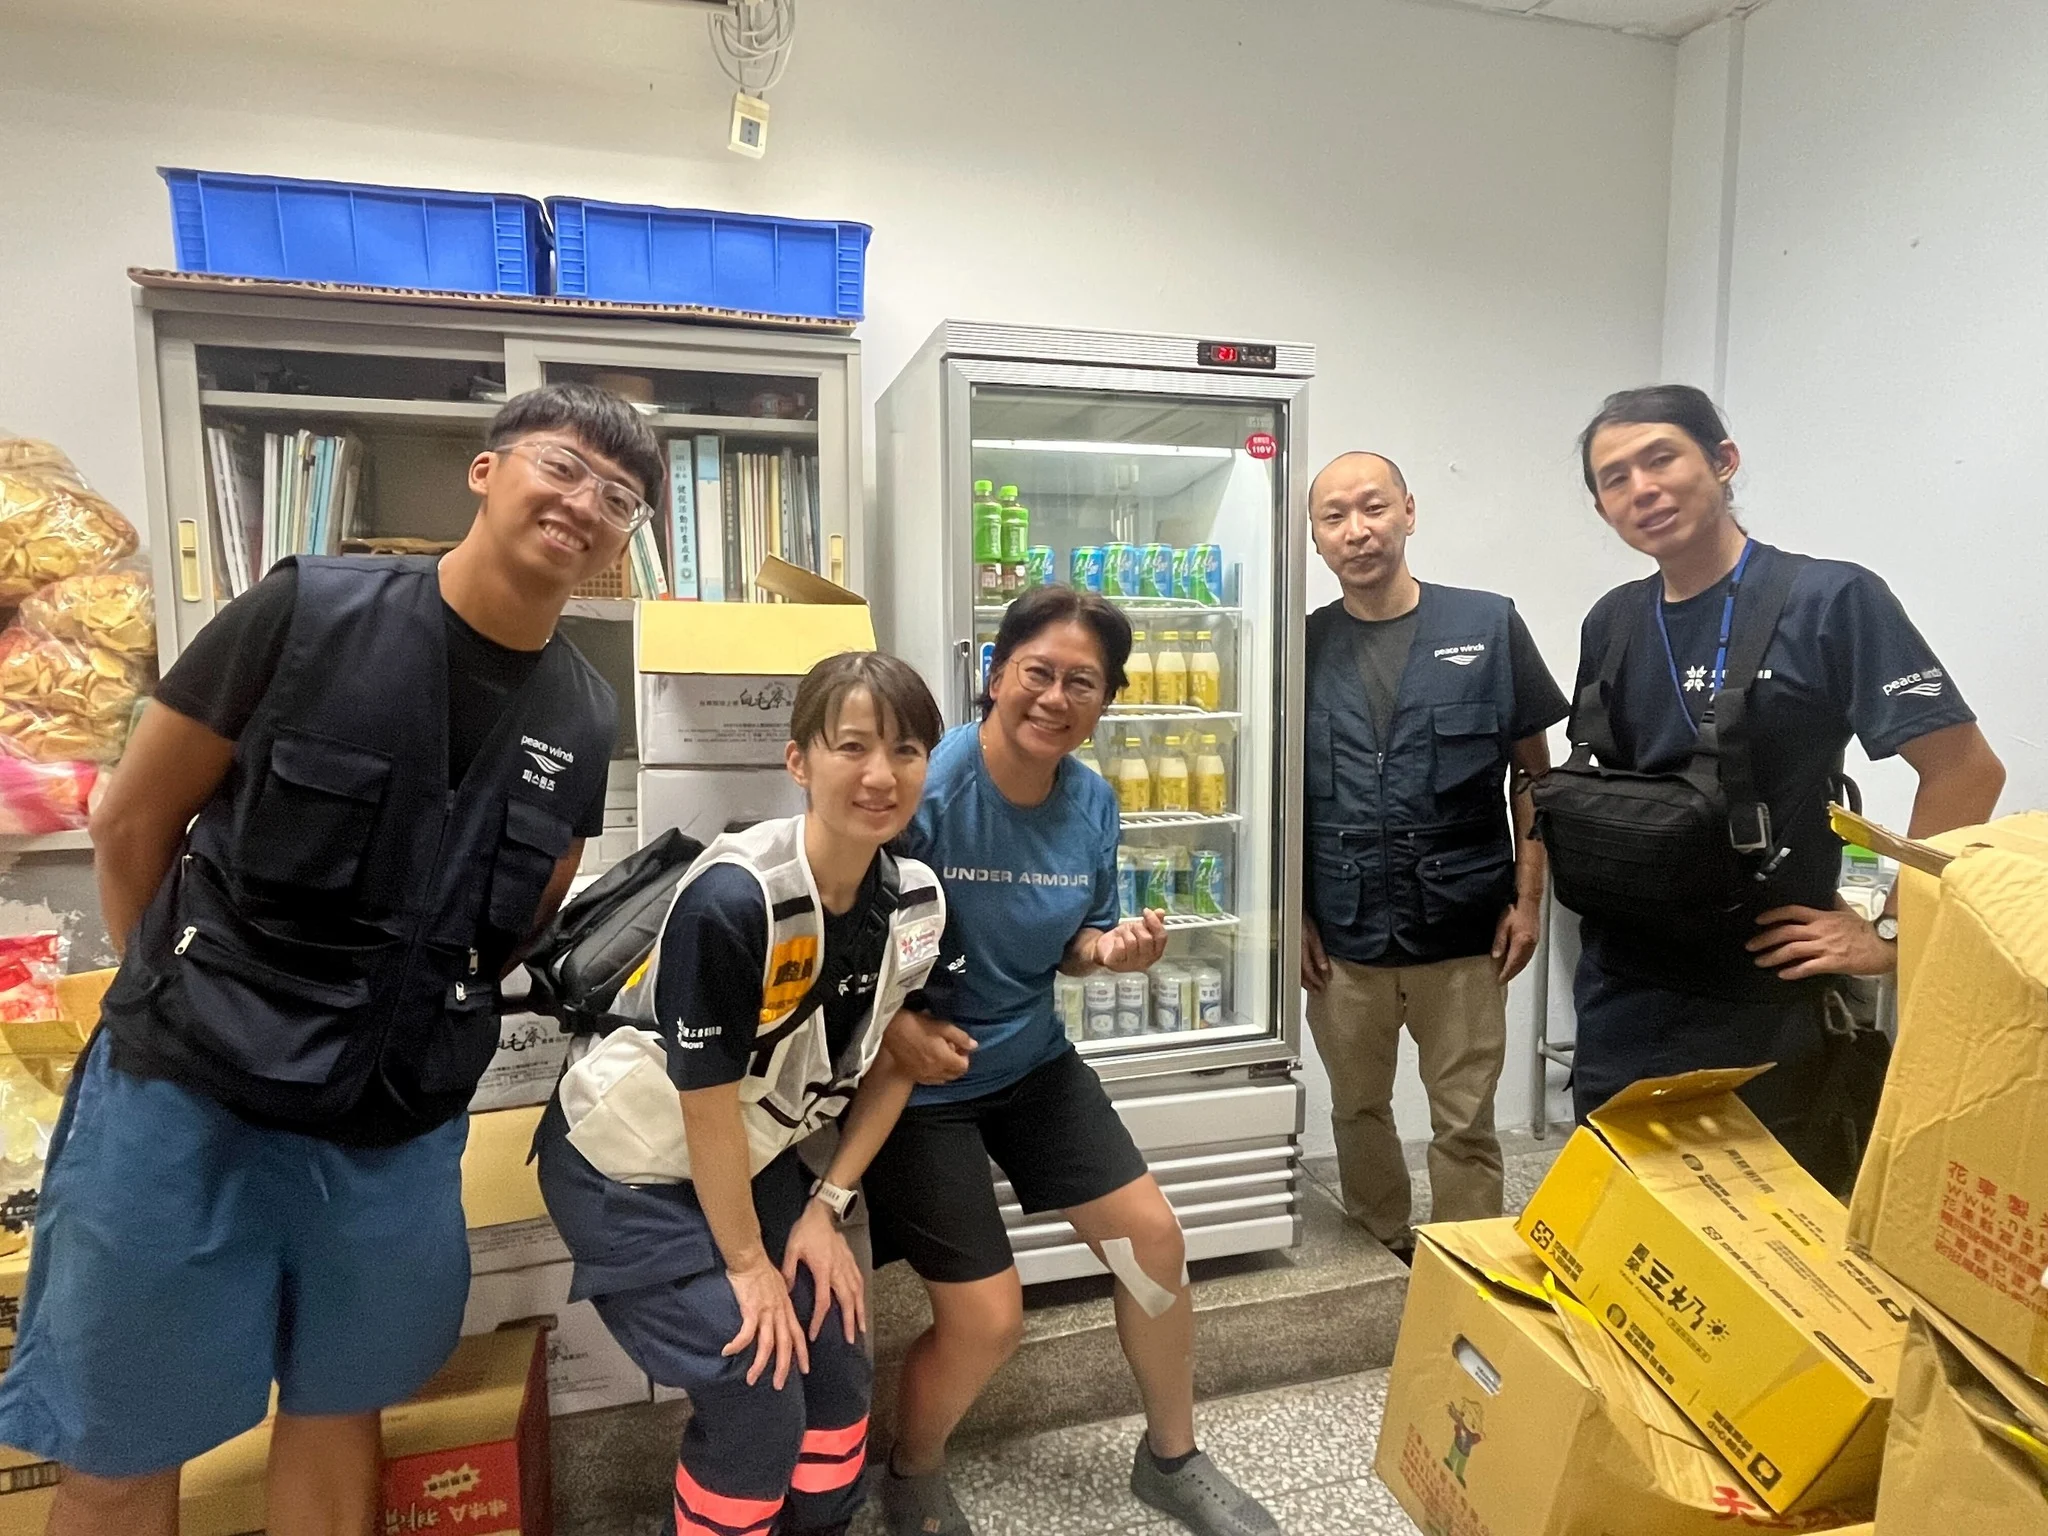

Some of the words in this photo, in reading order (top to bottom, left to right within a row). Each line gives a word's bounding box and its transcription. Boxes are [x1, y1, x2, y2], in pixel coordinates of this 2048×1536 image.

[1252, 445, 1271, 454] 110V
[1433, 647, 1459, 658] peace
[1460, 643, 1485, 652] winds
[1882, 673, 1922, 696] peace
[520, 735, 548, 752] peace
[549, 746, 575, 763] winds
[943, 866, 1013, 883] UNDER
[1018, 871, 1089, 886] ARMOUR
